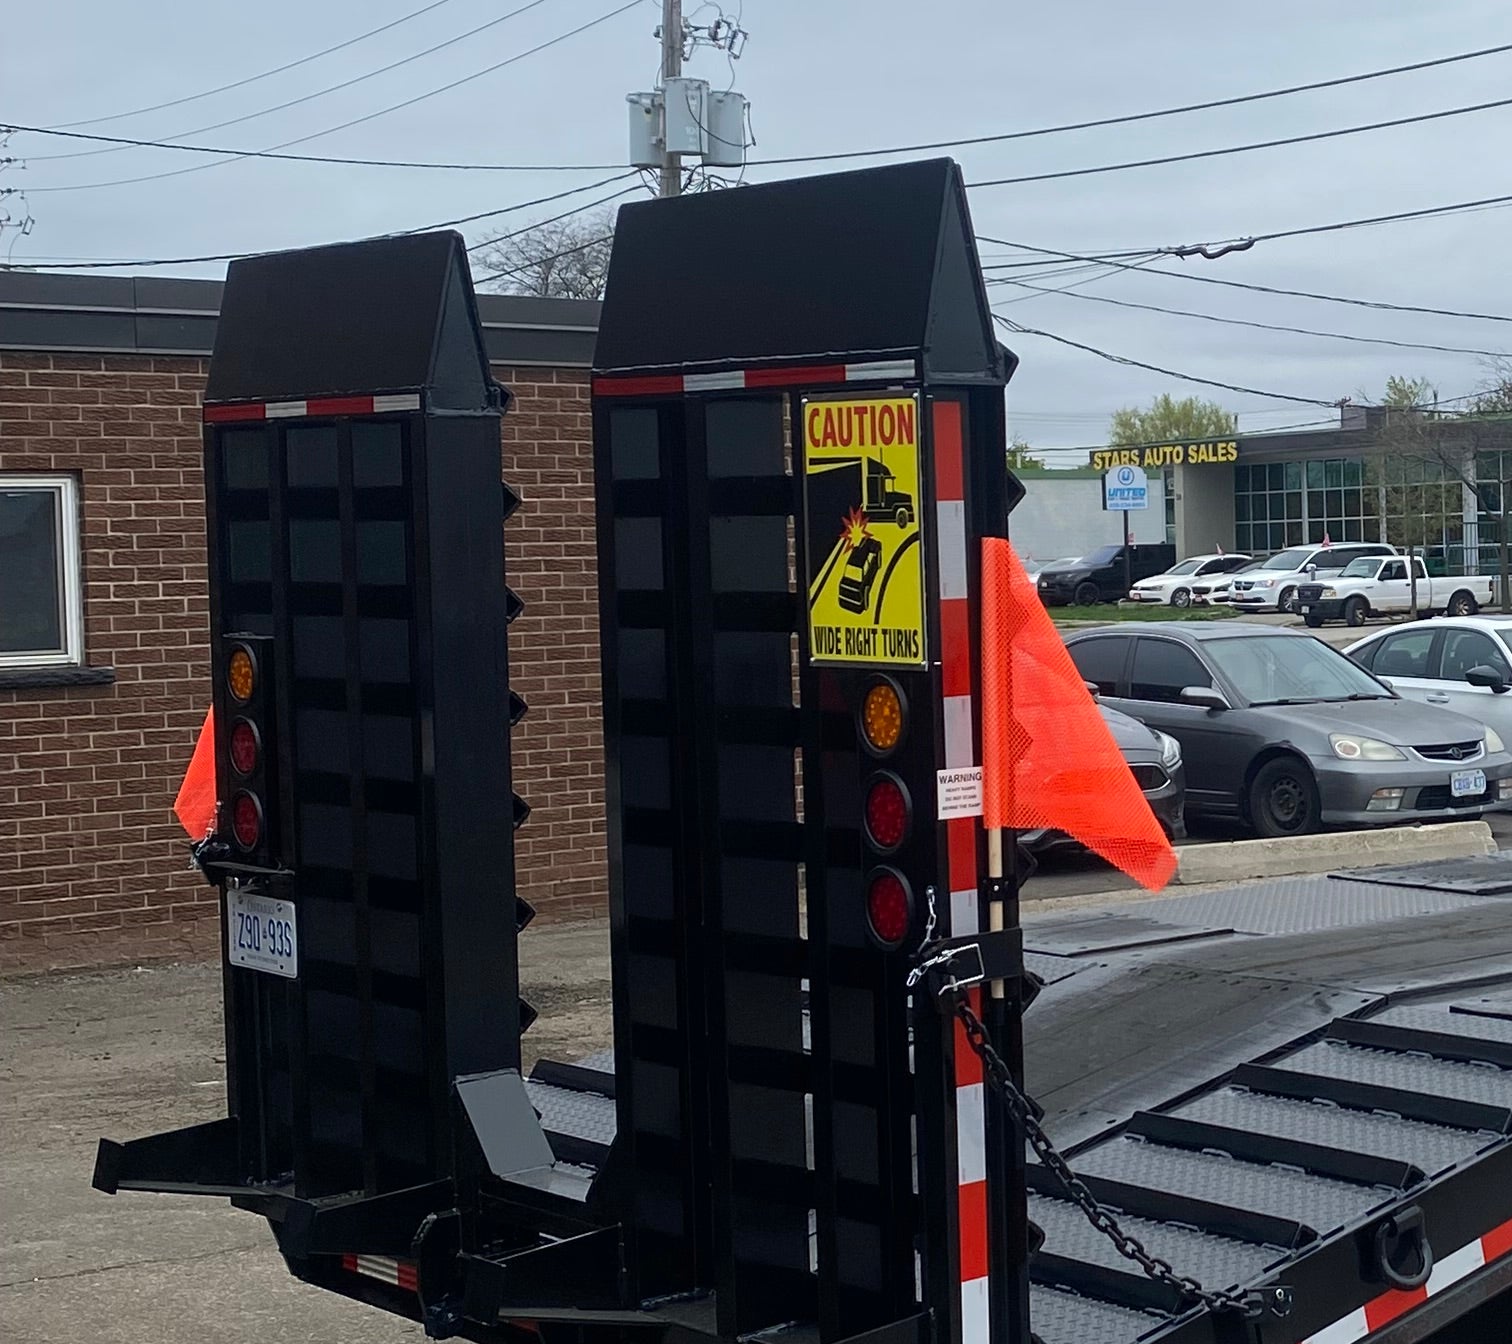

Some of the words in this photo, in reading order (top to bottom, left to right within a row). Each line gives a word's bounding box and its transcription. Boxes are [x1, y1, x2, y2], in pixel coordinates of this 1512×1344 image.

[808, 404, 914, 448] CAUTION
[1093, 449, 1140, 471] STARS
[1143, 445, 1184, 467] AUTO
[1187, 442, 1238, 464] SALES
[1108, 487, 1146, 497] UNITED
[813, 626, 842, 656] WIDE
[845, 626, 878, 657] RIGHT
[881, 627, 919, 659] TURNS
[938, 771, 983, 784] WARNING
